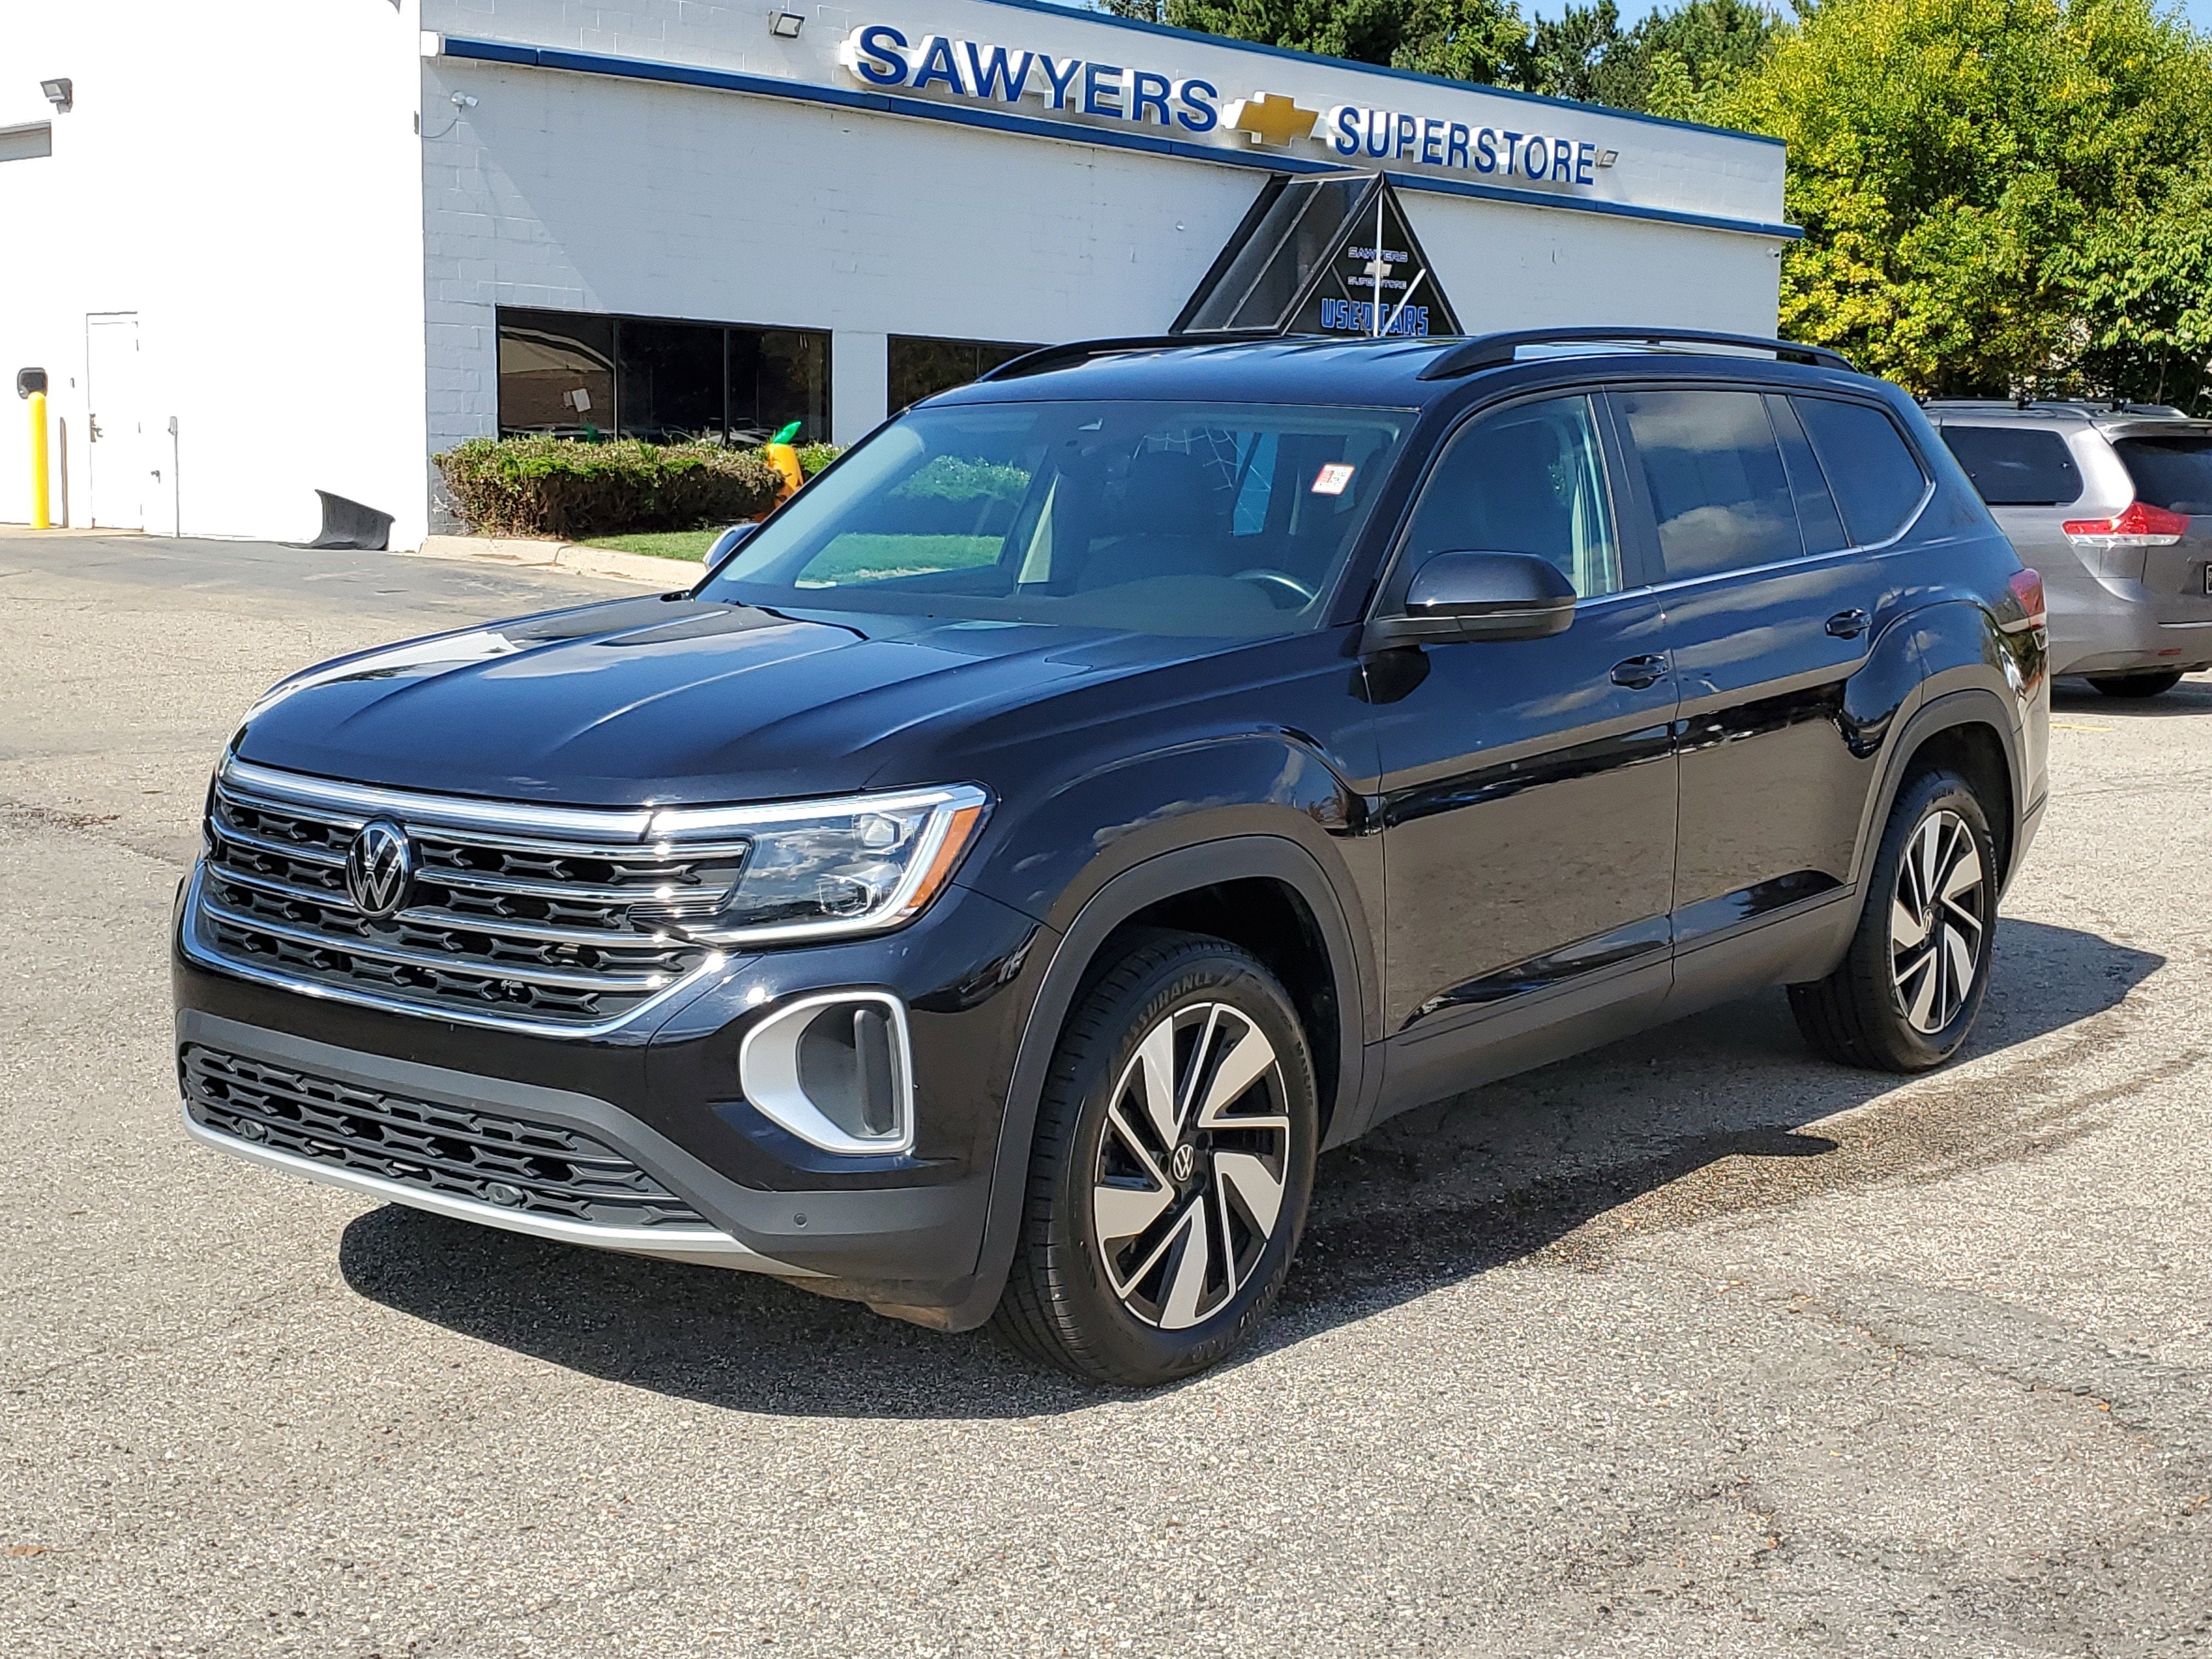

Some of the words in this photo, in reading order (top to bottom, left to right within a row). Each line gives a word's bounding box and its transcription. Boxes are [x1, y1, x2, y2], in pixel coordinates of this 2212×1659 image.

[856, 25, 1219, 133] SAWYERS
[1334, 105, 1596, 185] SUPERSTORE
[1321, 298, 1374, 331] USED
[1379, 303, 1429, 336] CARS
[1122, 971, 1212, 1049] ASSURANCE
